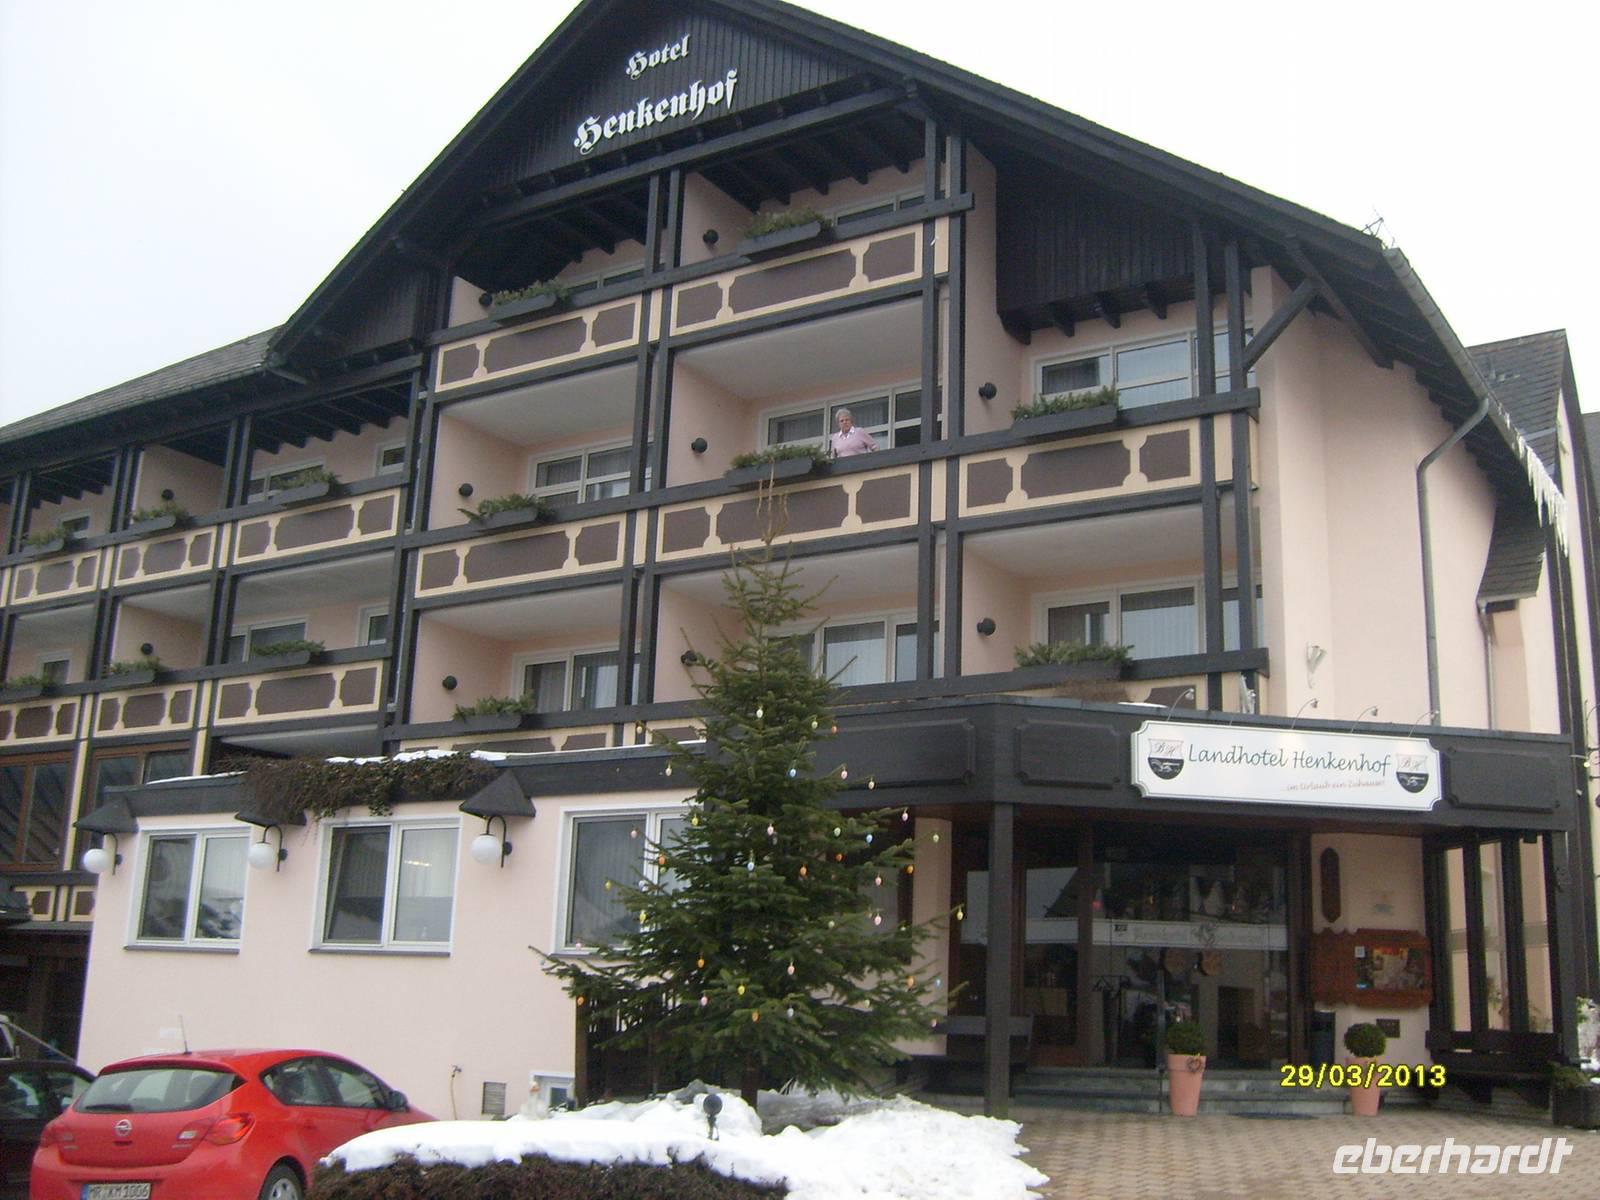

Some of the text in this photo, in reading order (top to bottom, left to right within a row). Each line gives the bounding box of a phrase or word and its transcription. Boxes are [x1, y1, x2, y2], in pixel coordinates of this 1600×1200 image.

[625, 33, 690, 80] Hotel
[574, 68, 738, 155] Henkenhof
[1187, 743, 1392, 777] Landhotel Henkenhof
